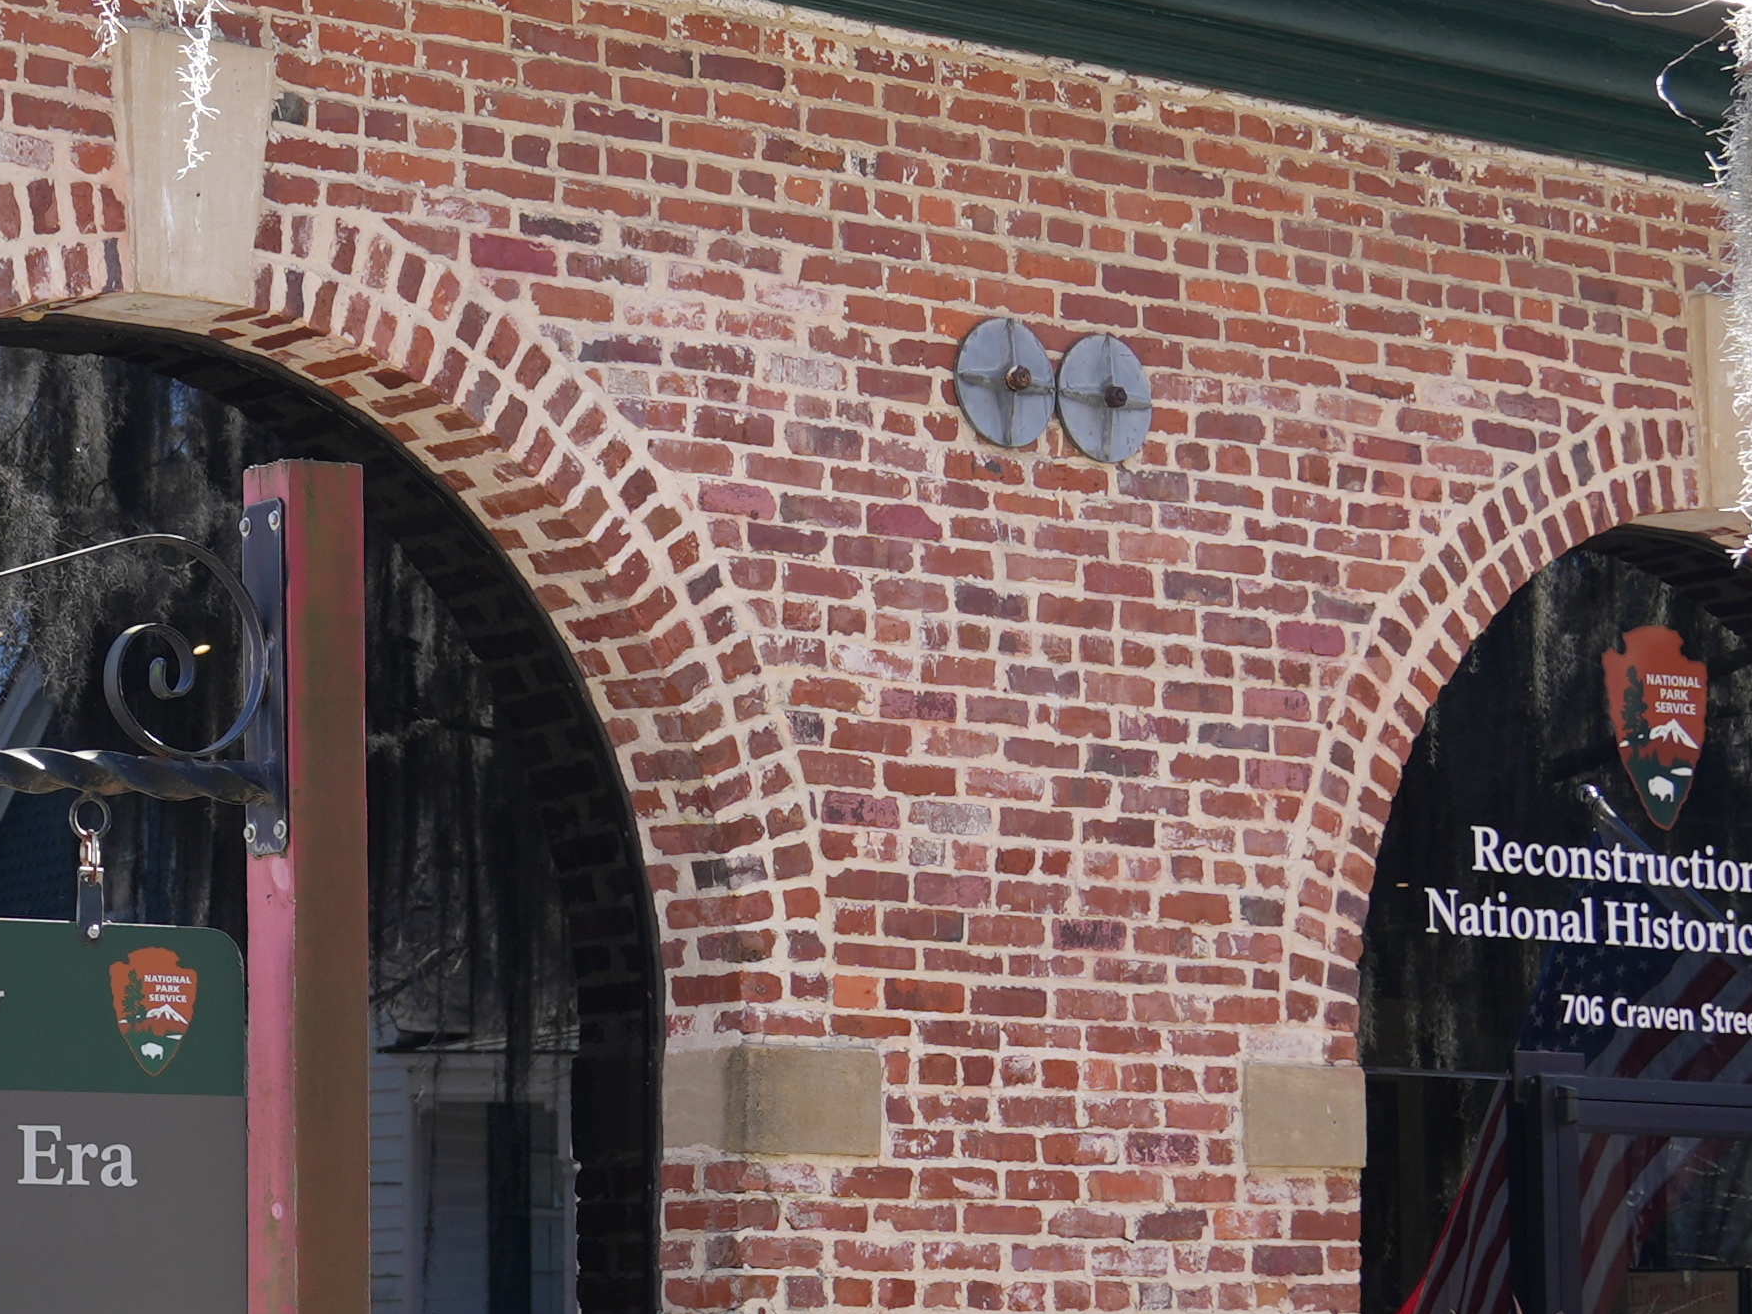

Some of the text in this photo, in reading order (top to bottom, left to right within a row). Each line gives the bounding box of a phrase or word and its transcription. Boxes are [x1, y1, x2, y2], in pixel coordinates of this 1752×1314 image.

[1646, 674, 1701, 688] NATIONAL
[1660, 688, 1688, 700] PARK
[1655, 701, 1696, 715] SERVICE
[1424, 887, 1596, 944] National
[144, 975, 192, 984] NATIONAL
[156, 985, 180, 993] PARK
[149, 994, 187, 1003] SERVICE
[1560, 994, 1605, 1027] 706
[1610, 997, 1695, 1032] Craven
[17, 1123, 137, 1187] Era
